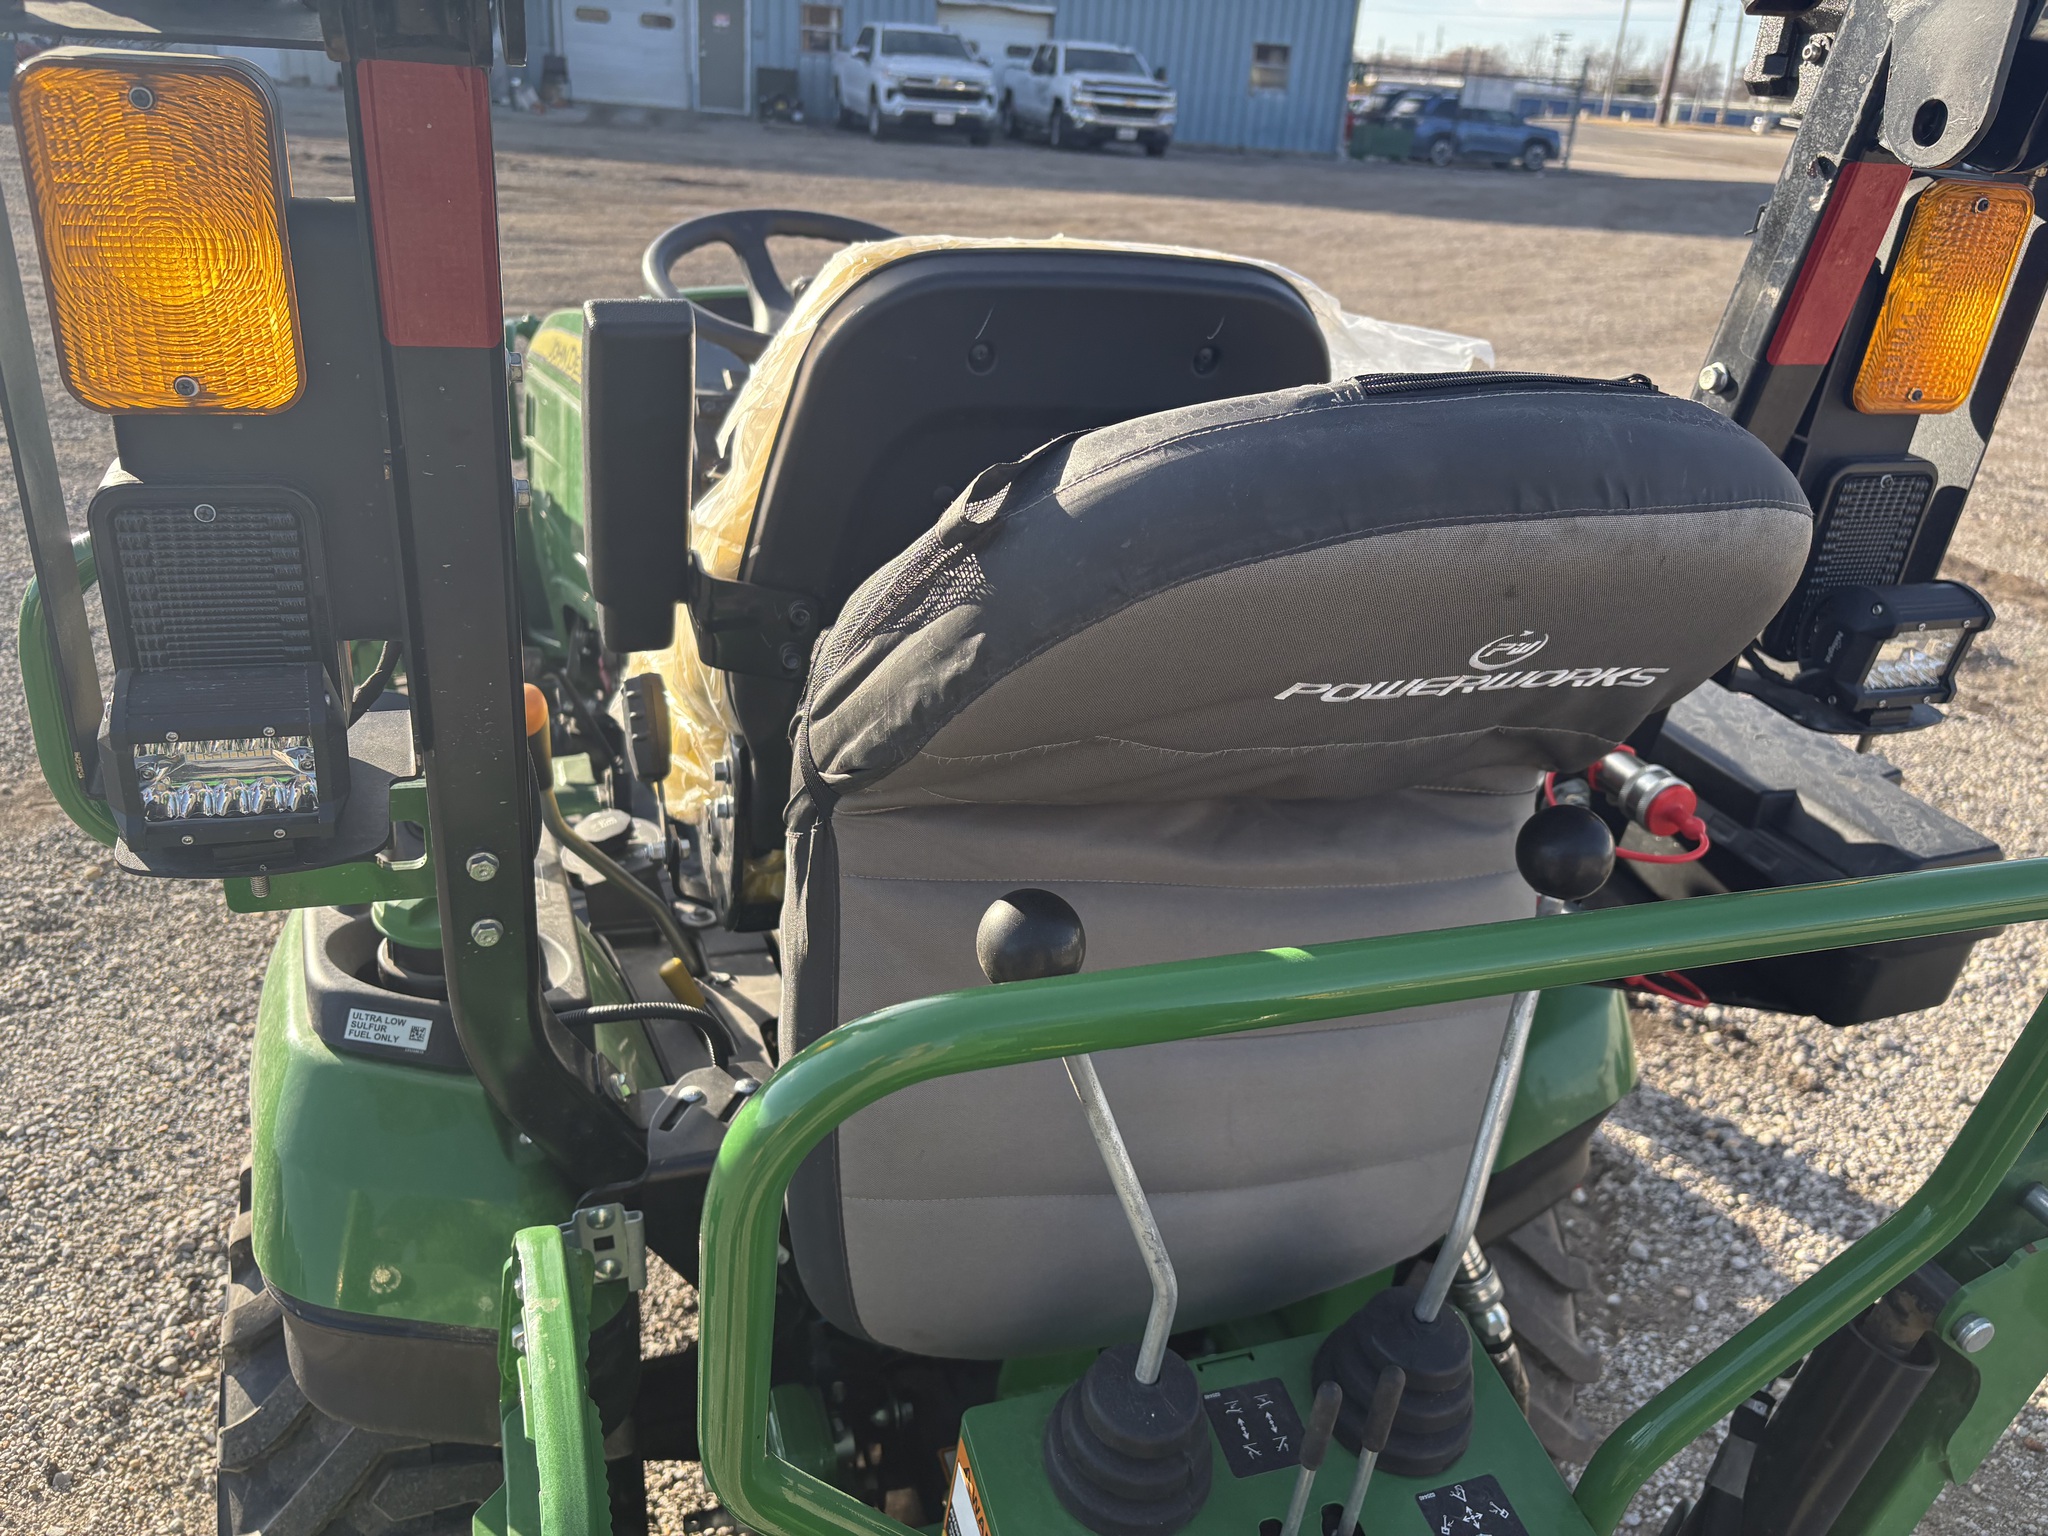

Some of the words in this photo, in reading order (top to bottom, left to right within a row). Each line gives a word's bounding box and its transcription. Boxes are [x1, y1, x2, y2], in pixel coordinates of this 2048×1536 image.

[1274, 666, 1670, 702] POWERWORKS
[350, 1020, 387, 1033] SULFUR
[352, 1011, 383, 1024] ULTRA
[385, 1016, 407, 1027] LOW
[348, 1028, 372, 1040] FUEL
[373, 1033, 400, 1044] ONLY
